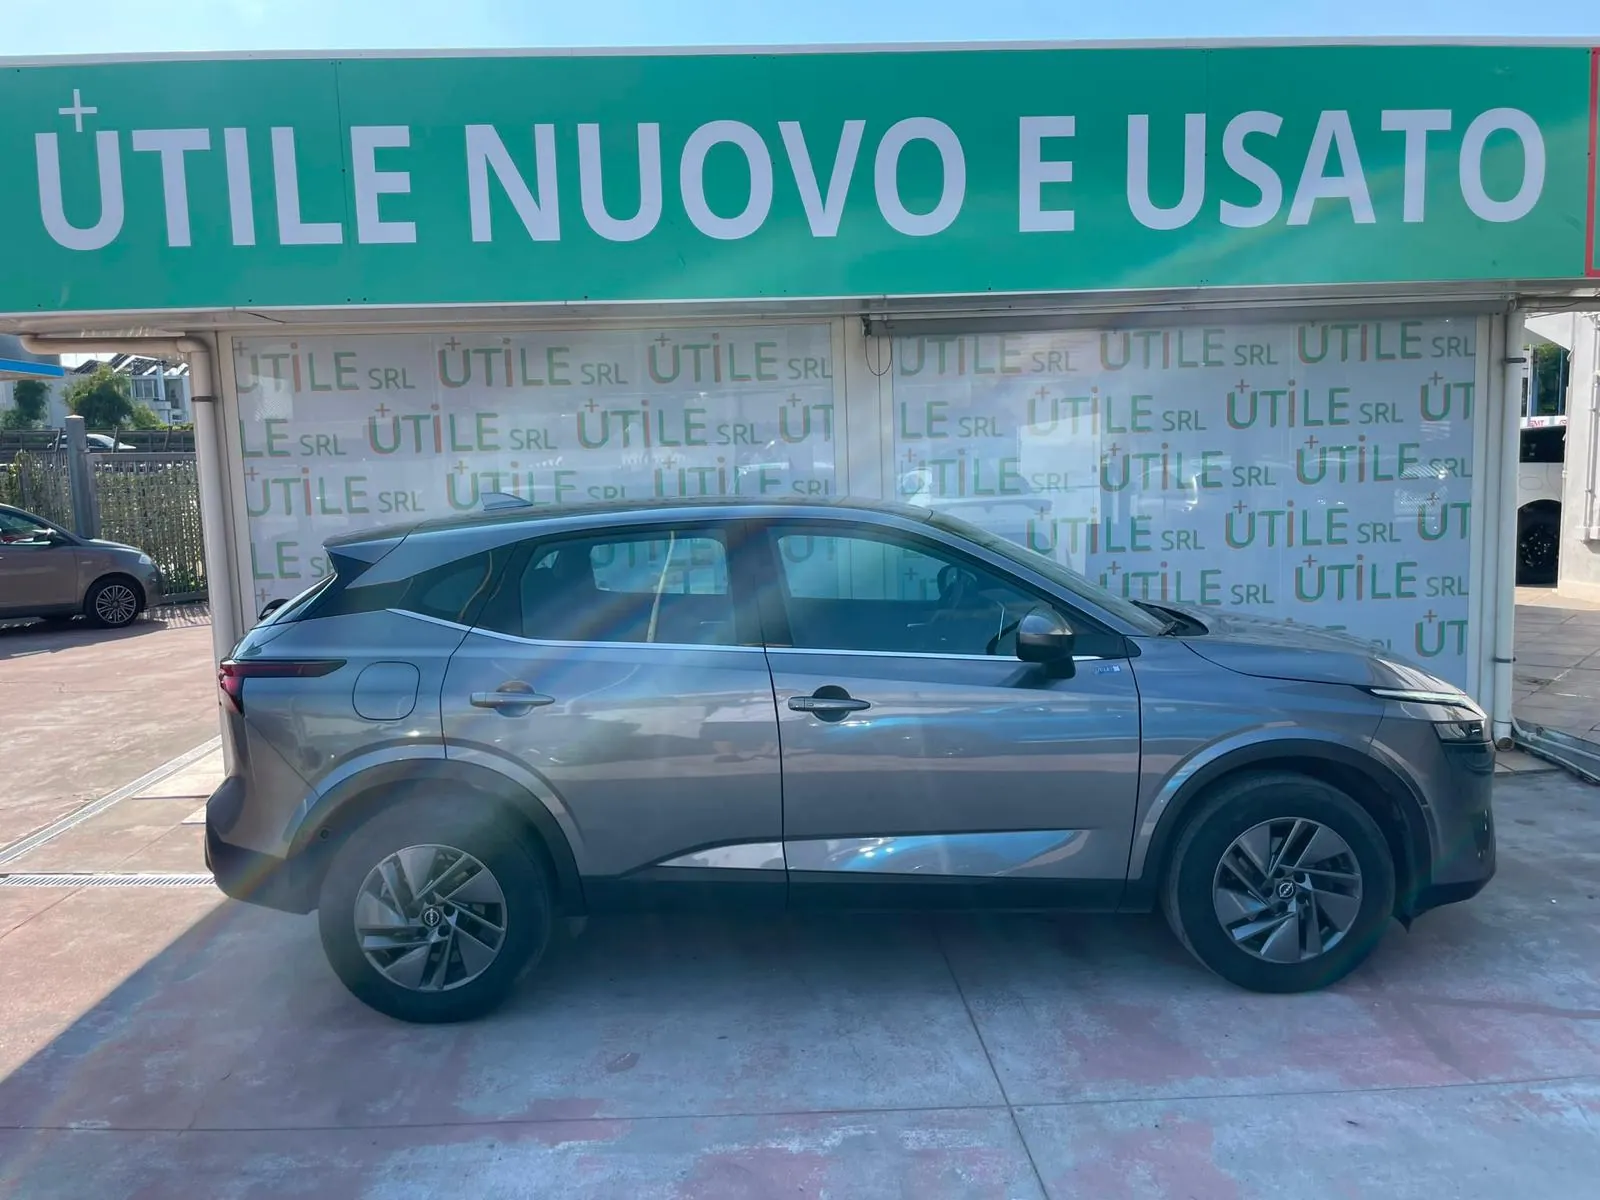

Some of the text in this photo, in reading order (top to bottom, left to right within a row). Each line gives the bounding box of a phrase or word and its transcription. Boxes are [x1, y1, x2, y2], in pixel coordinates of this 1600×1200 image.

[35, 107, 1546, 250] UTILE NUOVO E USATO
[1031, 351, 1077, 373] SRL
[1234, 344, 1278, 366] SRL
[1431, 337, 1475, 358] SRL
[368, 368, 415, 390] SRL
[581, 363, 628, 385] SRL
[788, 358, 832, 379] SRL
[901, 401, 949, 439] LE
[957, 416, 1004, 438] SRL
[1162, 410, 1206, 432] SRL
[1359, 402, 1403, 424] SRL
[240, 419, 291, 458] LE
[300, 434, 346, 456] SRL
[510, 428, 558, 450] SRL
[717, 424, 763, 445] SRL
[1031, 473, 1077, 493] SRL
[1232, 465, 1276, 487] SRL
[1429, 458, 1472, 478] SRL
[378, 491, 425, 513] SRL
[1161, 530, 1205, 551] SRL
[1357, 522, 1402, 543] SRL
[1230, 584, 1274, 604] SRL
[1425, 576, 1469, 597] SRL
